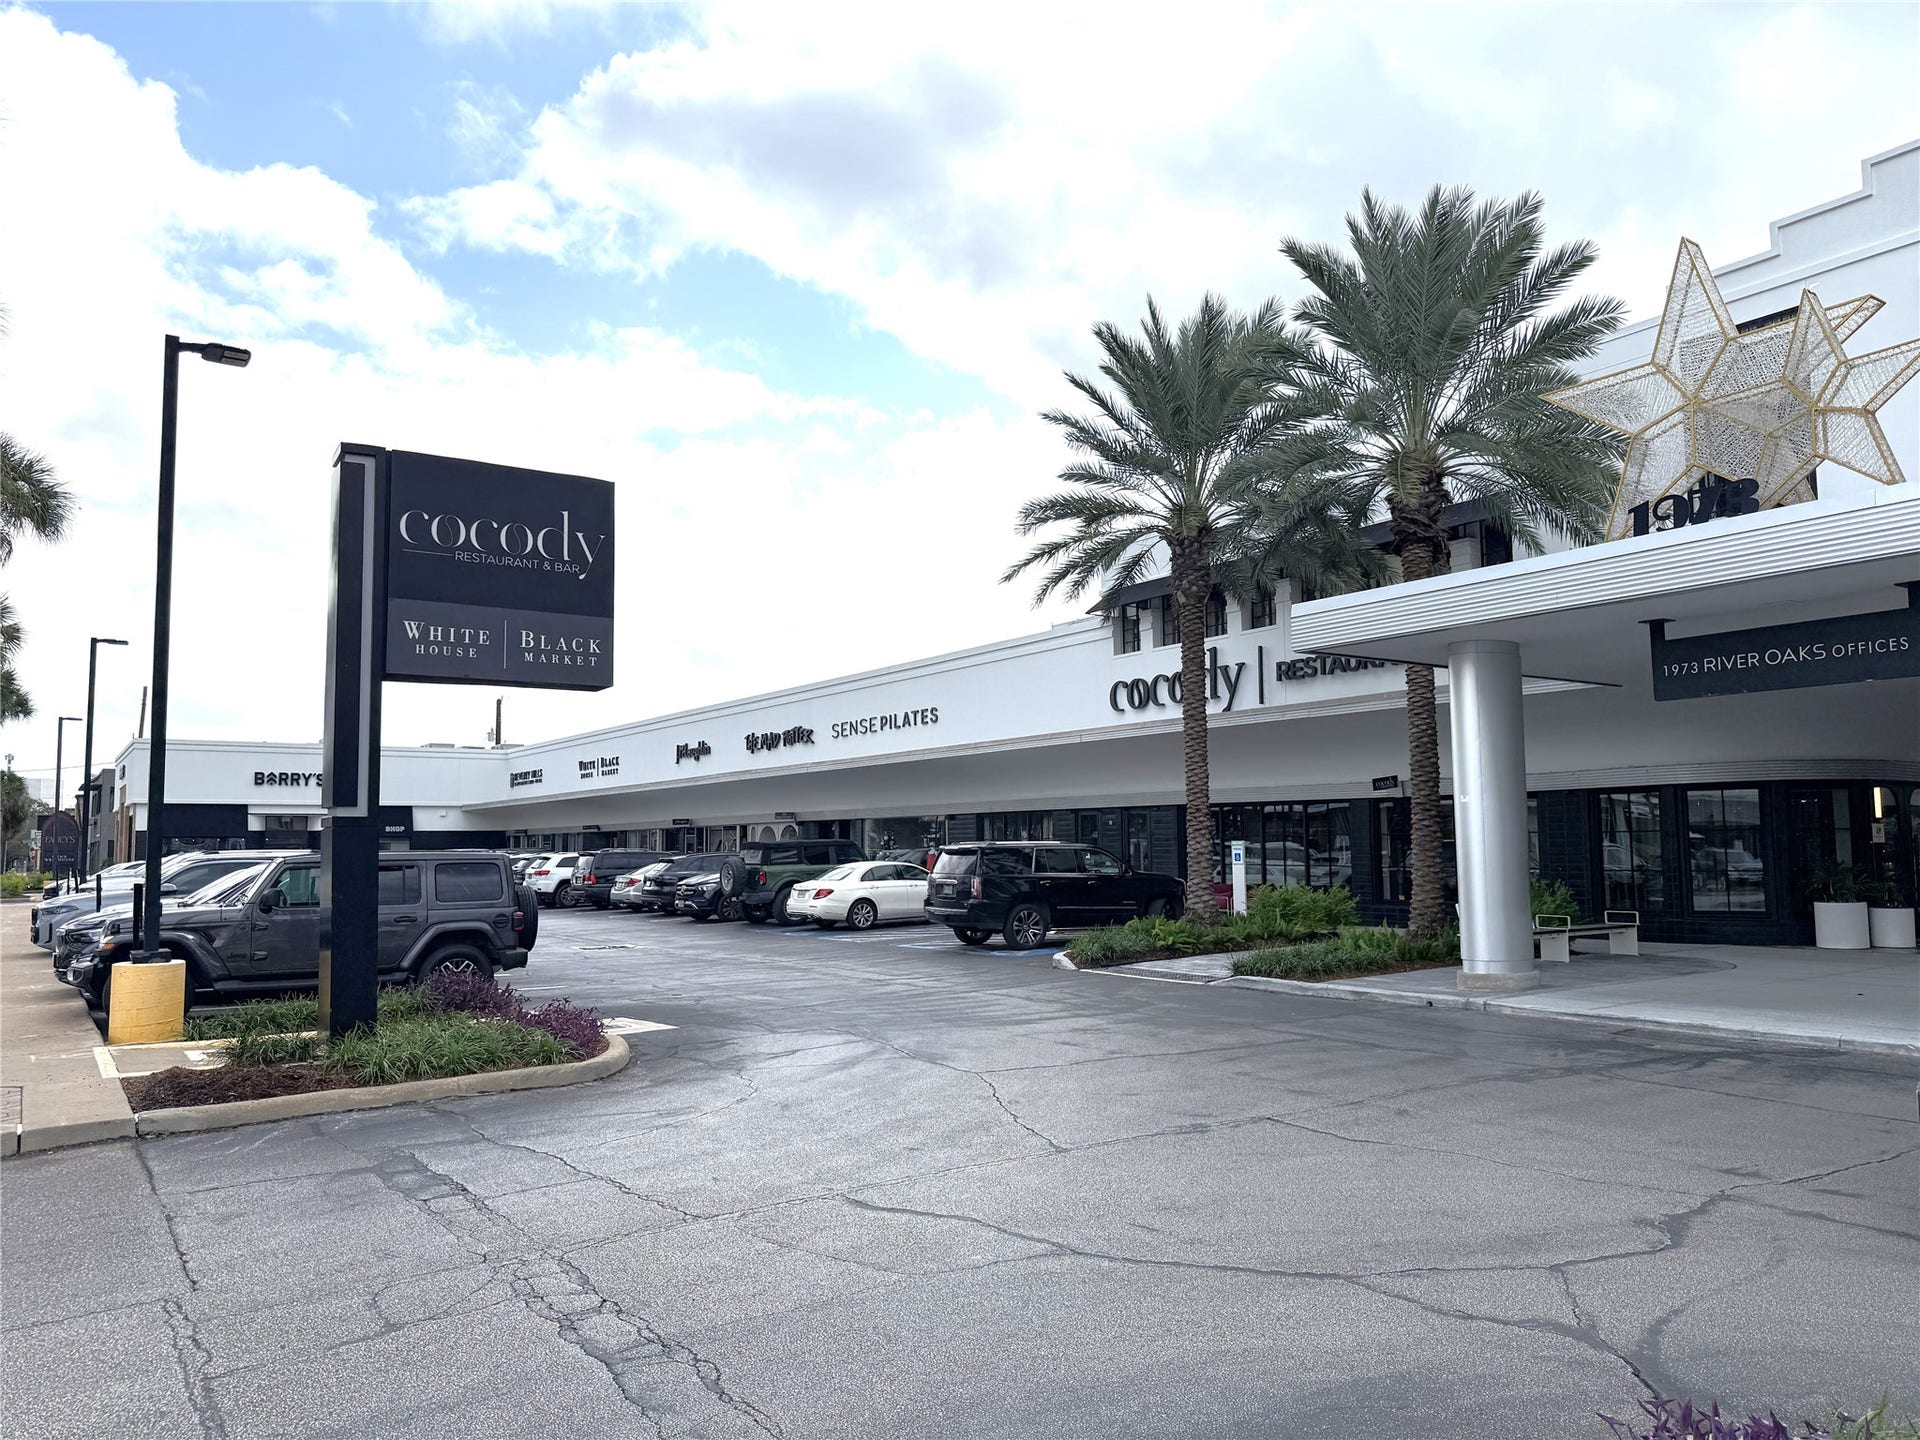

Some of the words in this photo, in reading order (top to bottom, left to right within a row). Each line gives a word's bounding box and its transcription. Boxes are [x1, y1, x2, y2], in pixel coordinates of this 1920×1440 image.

[399, 509, 606, 580] cocody
[454, 550, 540, 570] RESTAURANT
[543, 560, 552, 571] &
[554, 562, 580, 574] BAR
[402, 620, 491, 645] WHITE
[520, 630, 601, 653] BLACK
[415, 644, 478, 658] HOUSE
[524, 652, 598, 666] MARKET
[1662, 662, 1700, 677] 1973
[1703, 652, 1760, 672] RIVER
[1764, 643, 1827, 665] OAKS
[1831, 637, 1910, 658] OFFICES
[760, 731, 781, 752] MAD
[782, 725, 815, 747] POTTER
